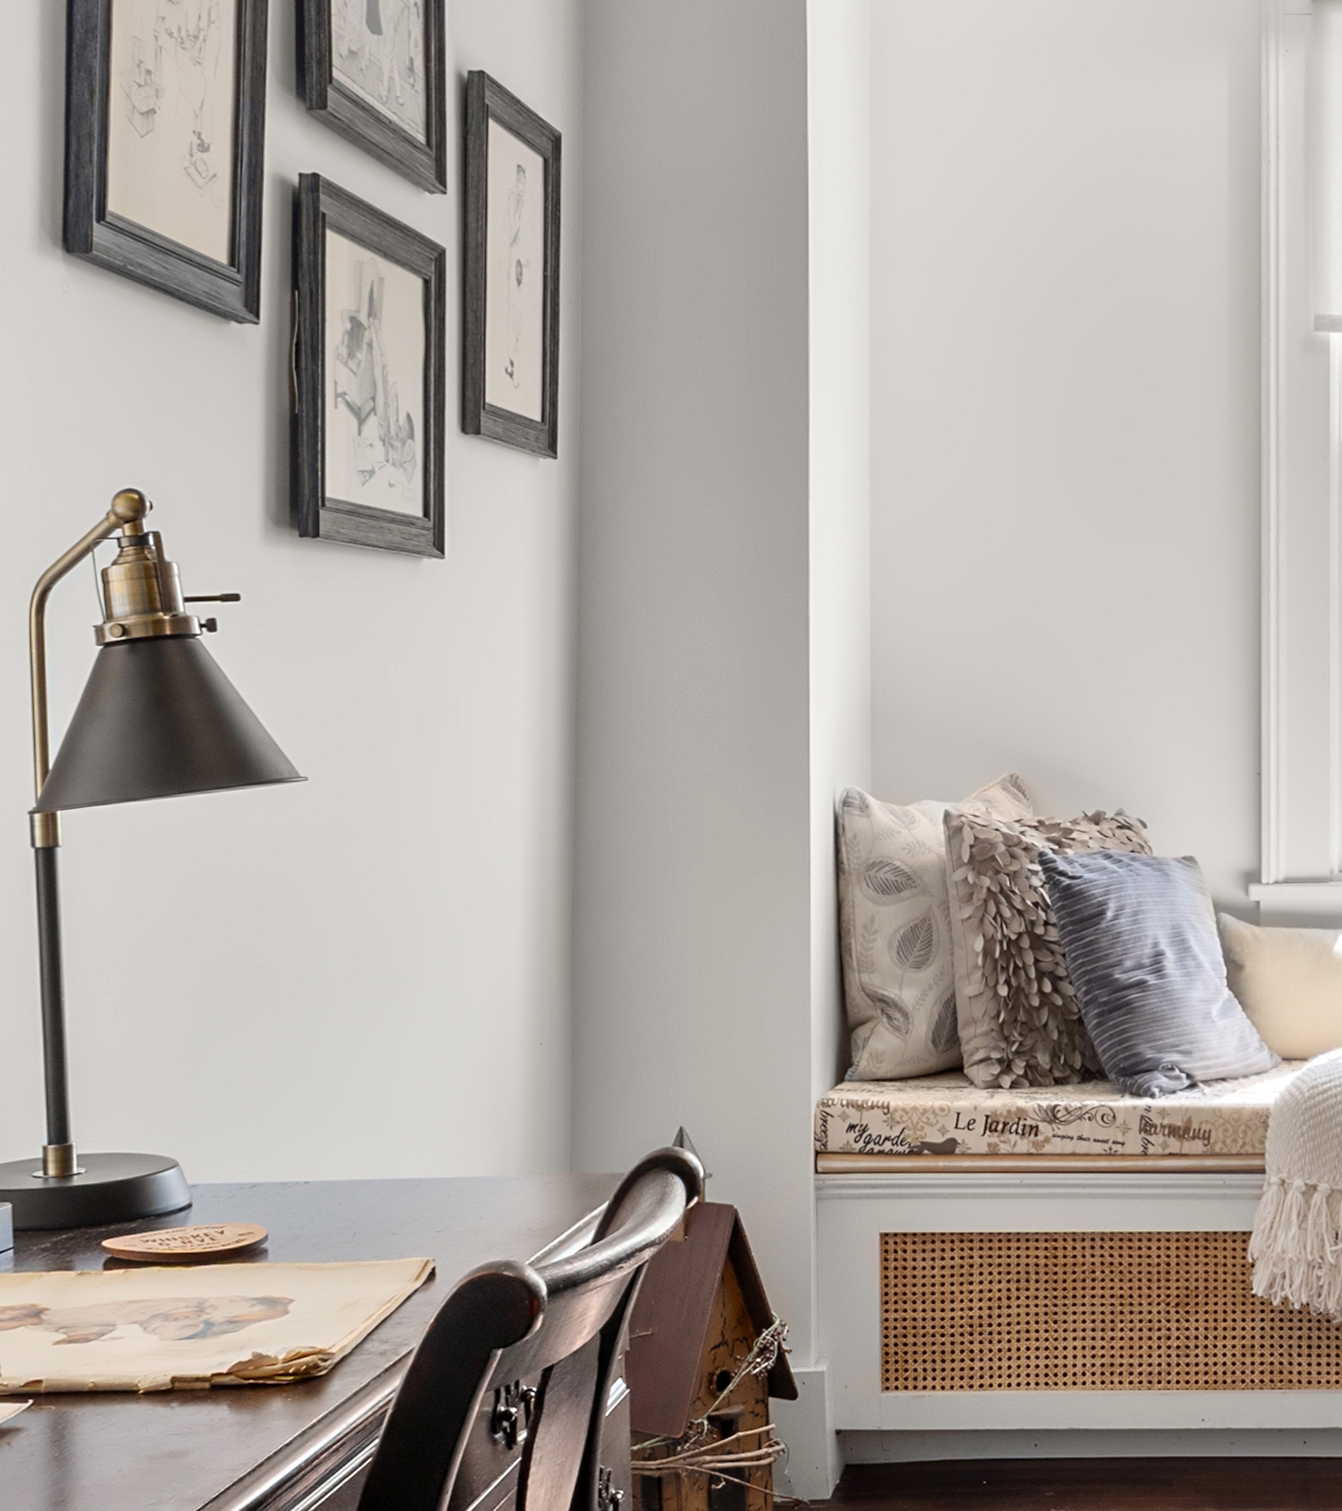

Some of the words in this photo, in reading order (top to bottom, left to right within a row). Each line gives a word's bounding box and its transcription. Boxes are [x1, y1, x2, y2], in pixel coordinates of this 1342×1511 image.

[815, 1110, 834, 1151] breeze
[846, 1121, 869, 1141] my
[954, 1112, 976, 1131] Le
[981, 1113, 1040, 1138] Jardin
